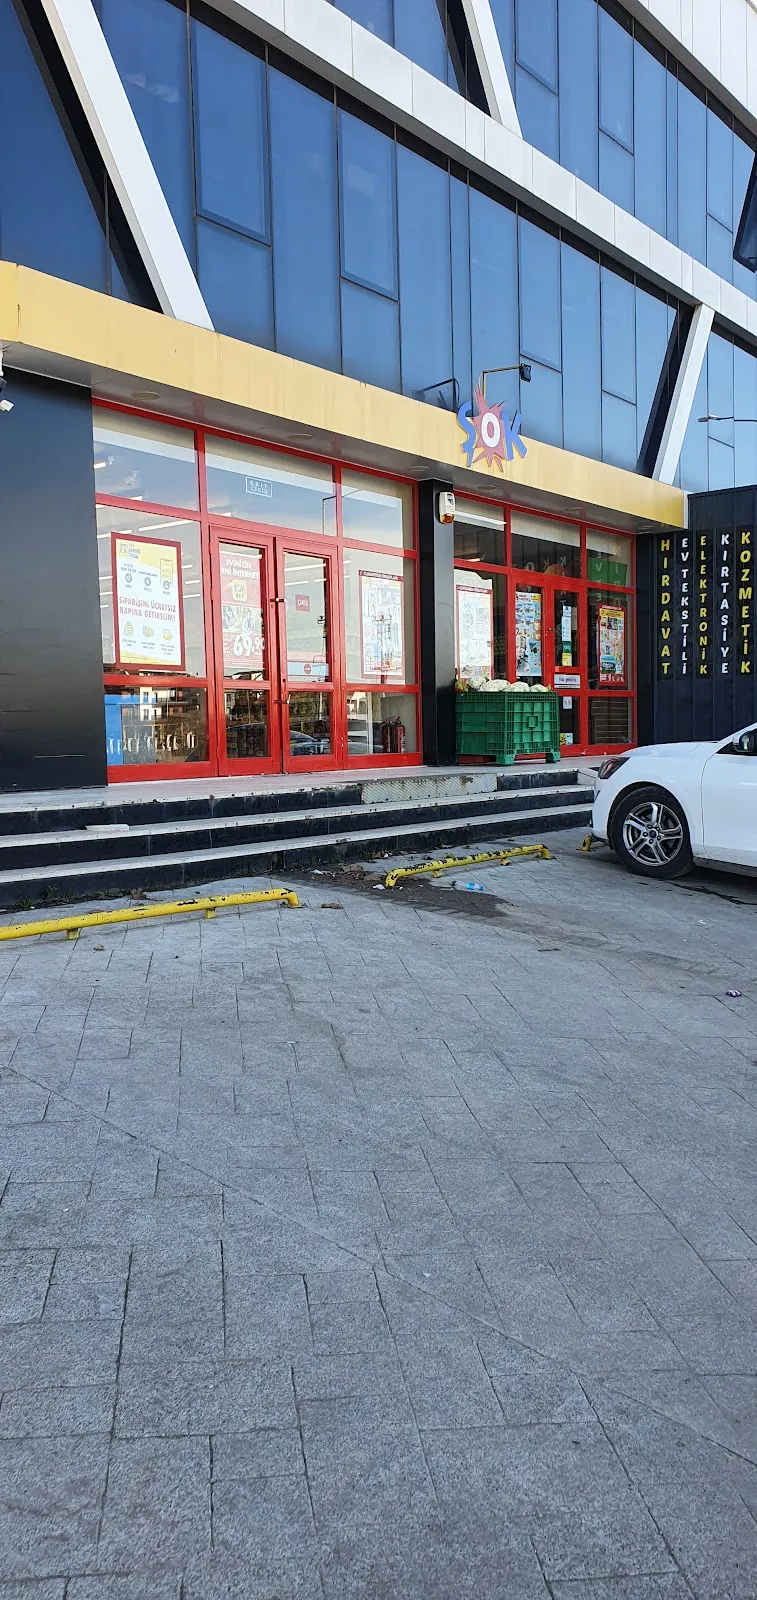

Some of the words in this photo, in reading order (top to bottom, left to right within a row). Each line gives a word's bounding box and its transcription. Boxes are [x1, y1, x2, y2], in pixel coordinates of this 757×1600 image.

[457, 400, 527, 467] ŞOK
[250, 480, 268, 489] EXIT
[226, 558, 252, 569] EVİNİZİN
[680, 537, 689, 562] EV
[119, 606, 143, 617] KAPINA
[150, 600, 176, 613] ÜCRETSİZ
[660, 538, 671, 675] HIRDAVAT
[680, 568, 689, 675] TEKSTİLİ
[699, 535, 708, 675] ELEKTRONİK
[720, 533, 730, 674] KIRTASİYE
[738, 531, 753, 674] KOZMETİK
